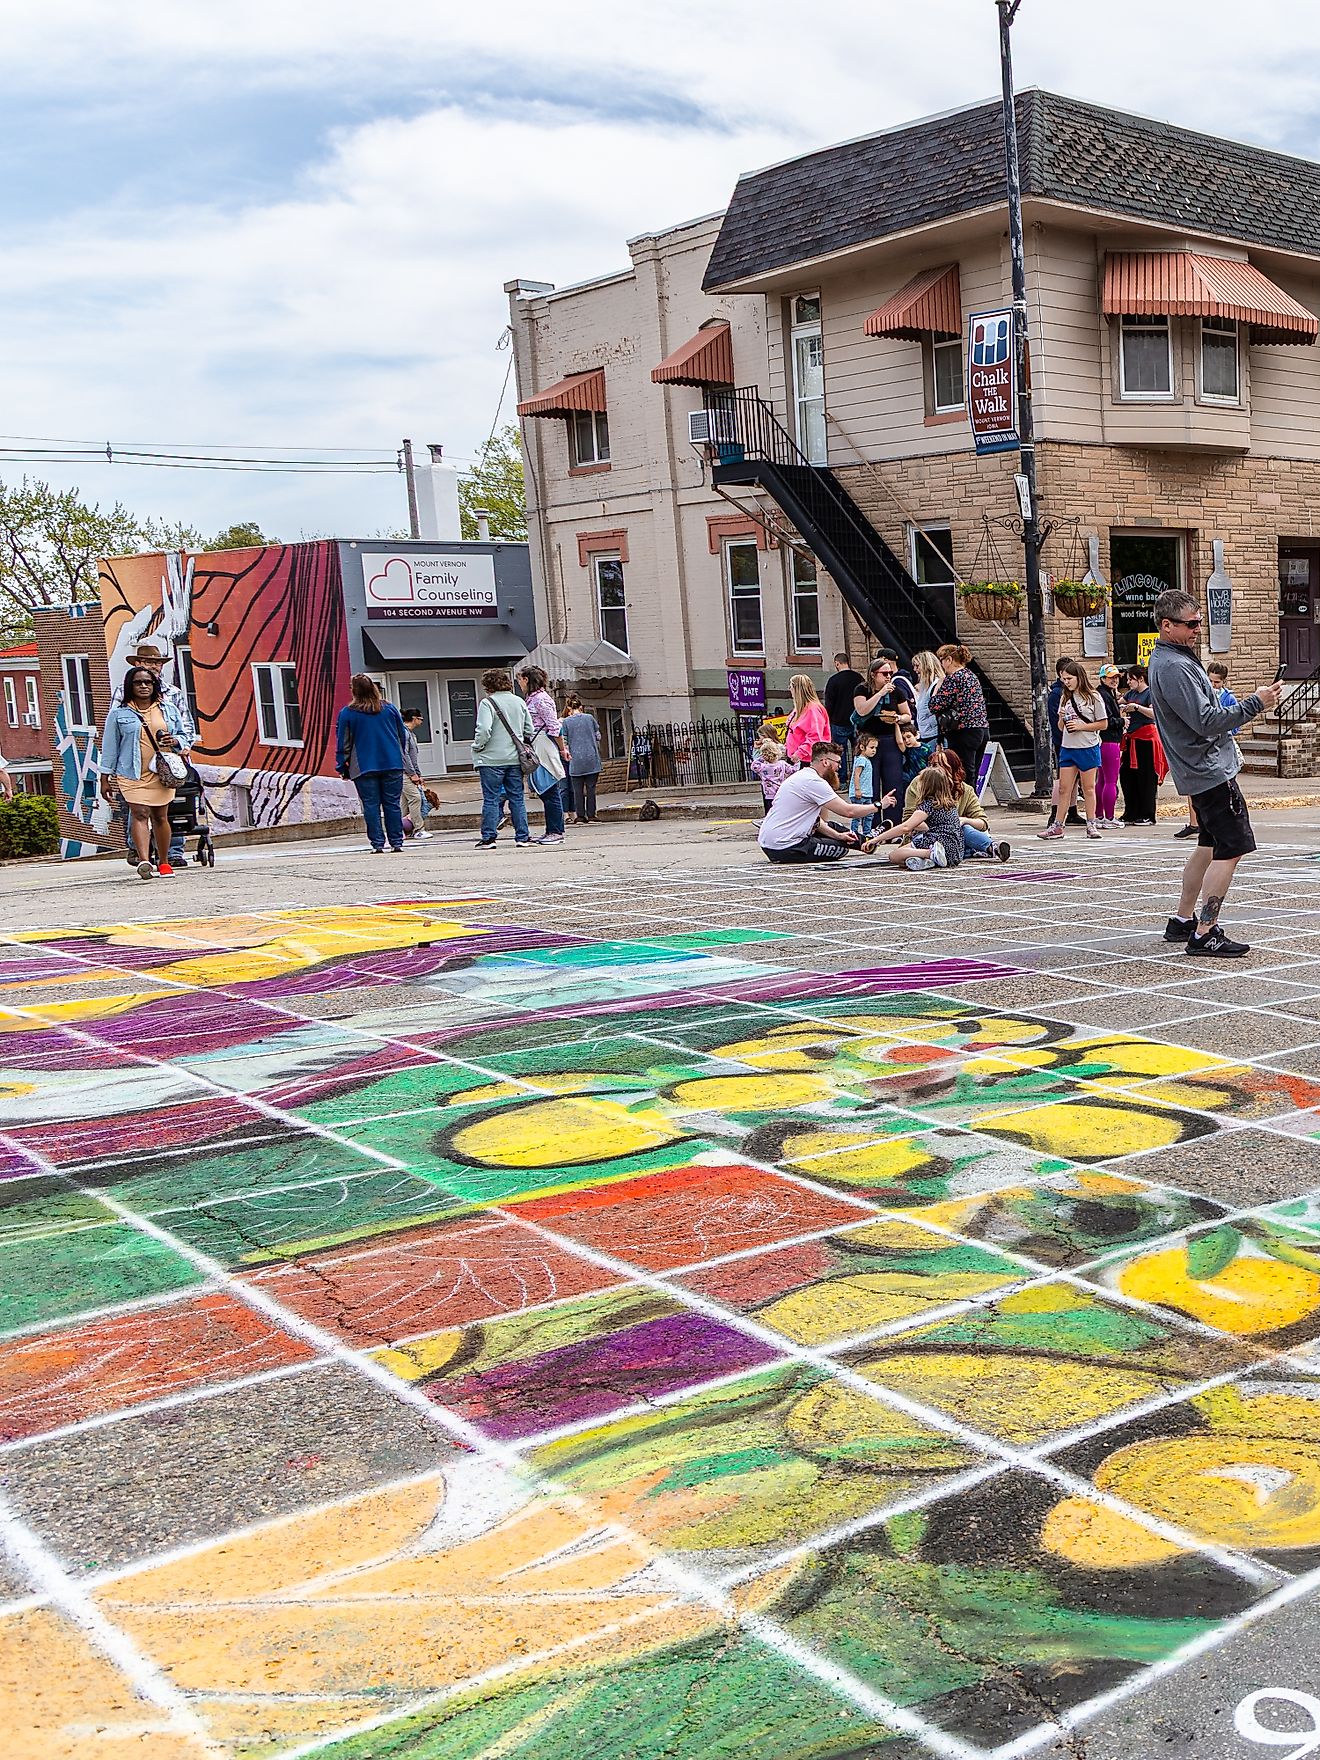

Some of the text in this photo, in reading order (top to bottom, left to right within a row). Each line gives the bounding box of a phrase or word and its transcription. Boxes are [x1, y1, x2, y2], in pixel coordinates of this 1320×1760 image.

[972, 367, 1010, 388] Chalk
[983, 387, 998, 397] THE
[975, 395, 1008, 415] Walk
[415, 572, 459, 587] Family
[417, 588, 493, 603] Counseling
[1145, 591, 1159, 601] bar
[1210, 599, 1230, 608] HOURS
[383, 608, 483, 617] 104 SECOND AVENUE NW
[1120, 610, 1135, 618] wood
[1135, 610, 1149, 618] fired
[740, 675, 761, 686] HAPPY
[743, 687, 759, 697] DAZE
